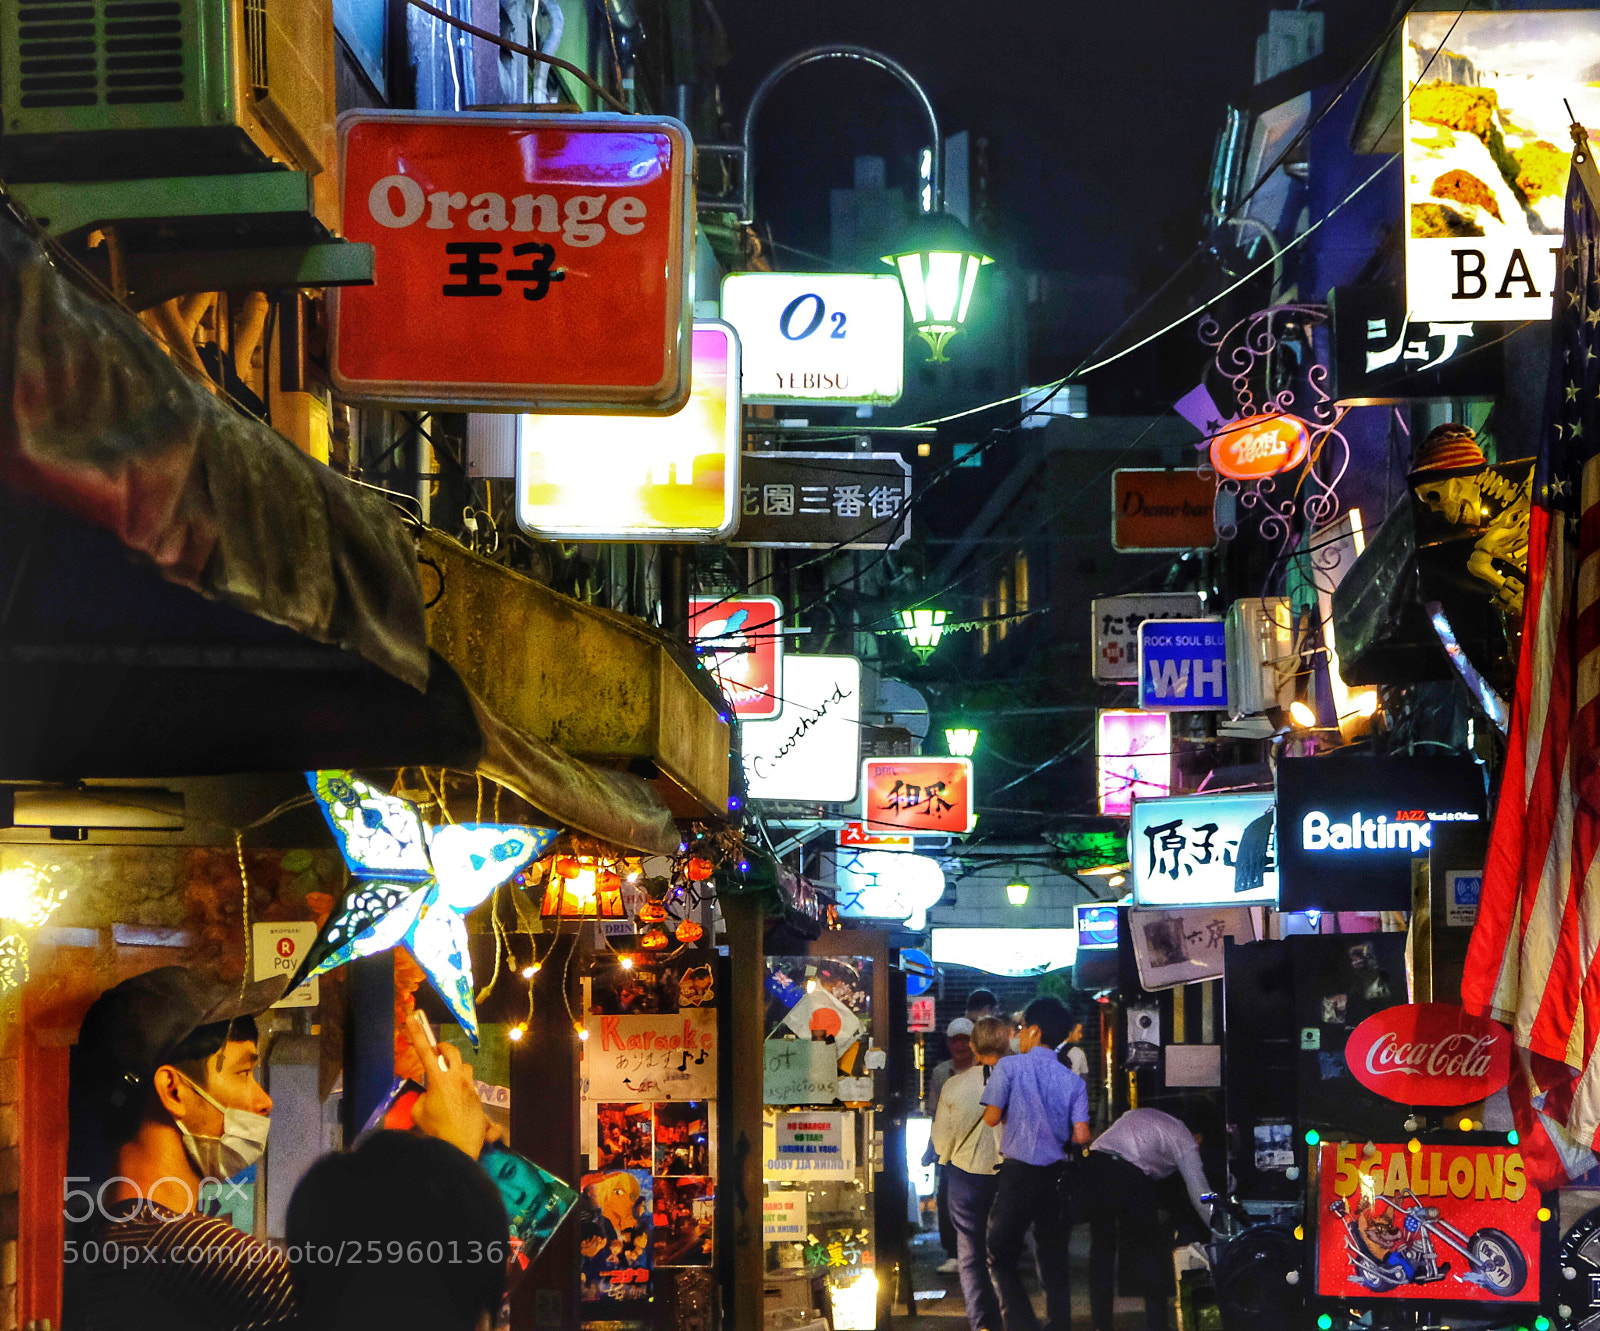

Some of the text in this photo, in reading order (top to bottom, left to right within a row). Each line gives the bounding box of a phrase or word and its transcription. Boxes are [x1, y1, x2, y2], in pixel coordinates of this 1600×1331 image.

[368, 174, 648, 248] Orange
[442, 241, 566, 300] 王子
[776, 372, 849, 389] YEBISU
[1144, 635, 1173, 647] ROCK
[1175, 635, 1203, 647] SOUL
[1395, 810, 1426, 821] JAZZ
[274, 957, 298, 971] Pay
[600, 1015, 714, 1053] Karaoke
[1365, 1031, 1499, 1079] Coca-Cola
